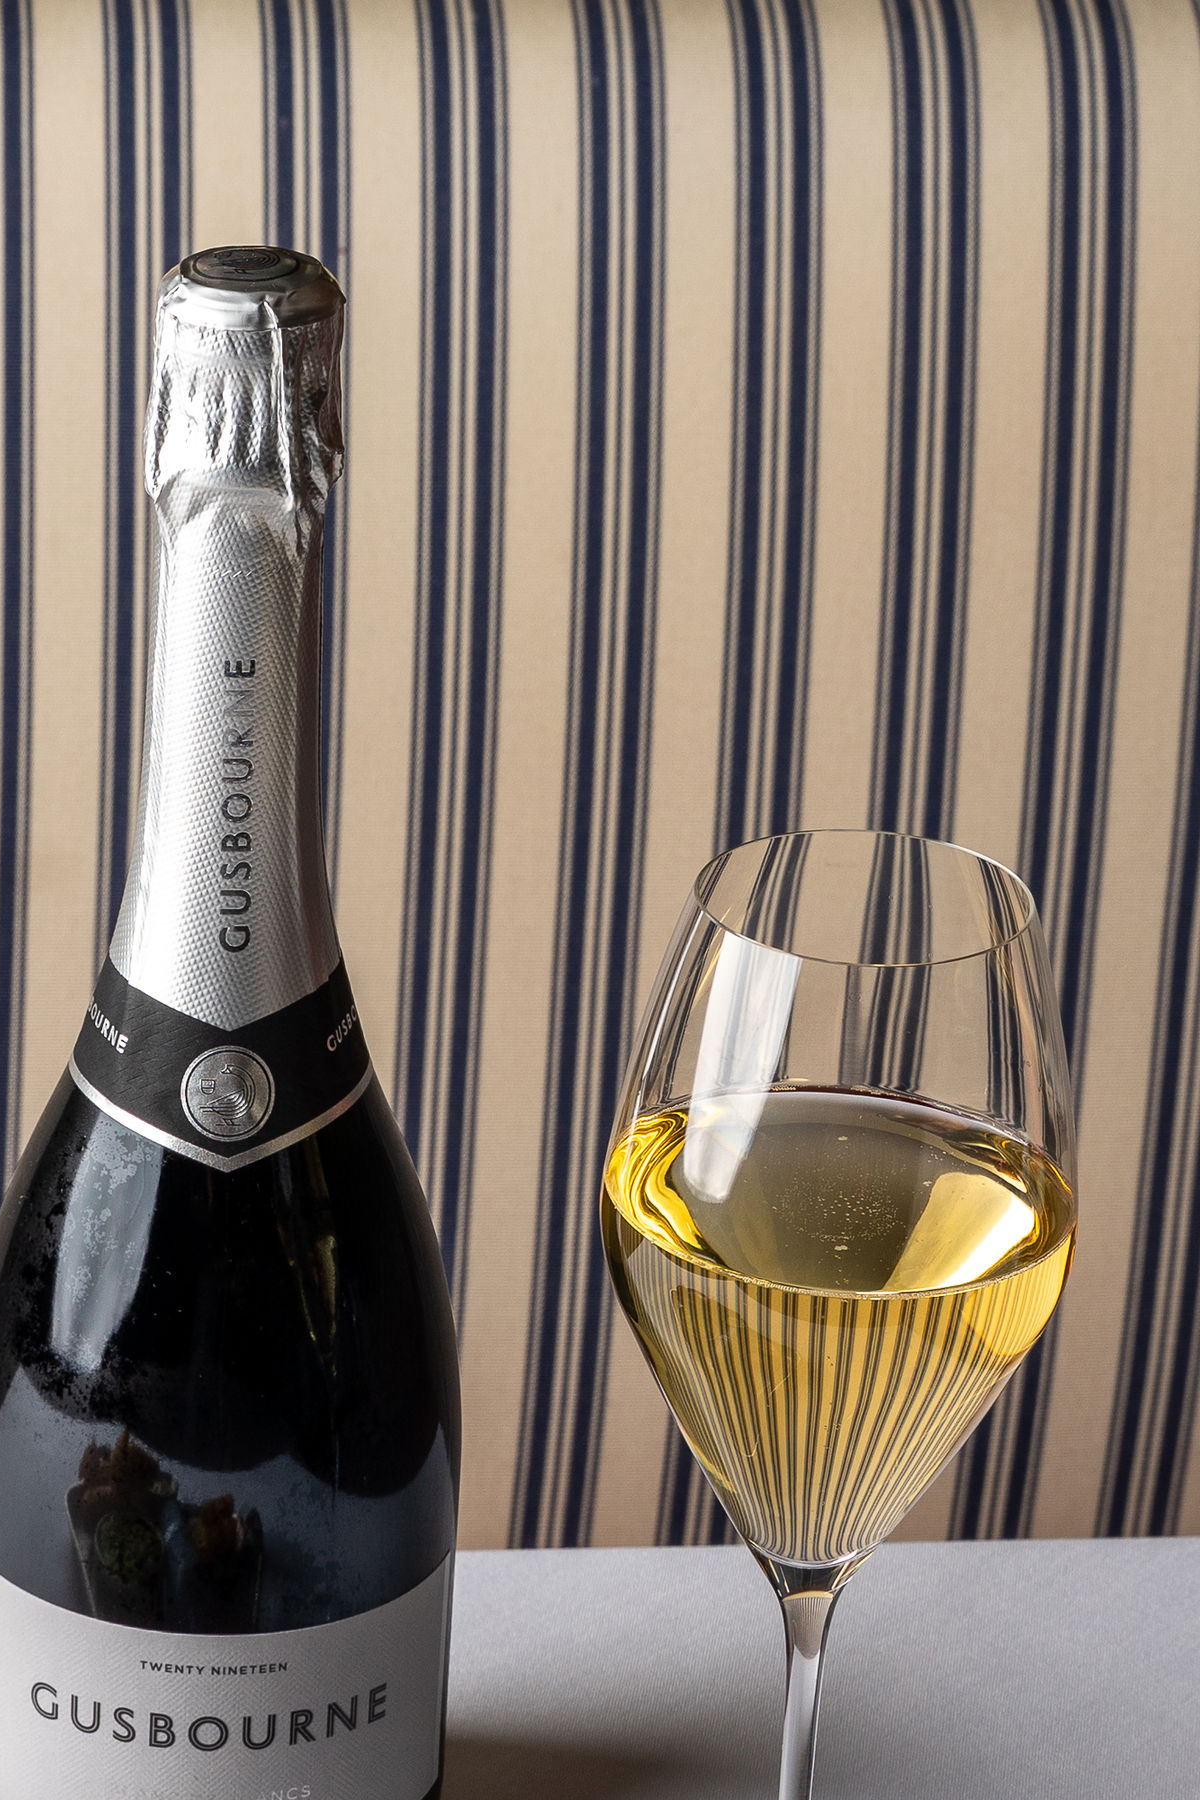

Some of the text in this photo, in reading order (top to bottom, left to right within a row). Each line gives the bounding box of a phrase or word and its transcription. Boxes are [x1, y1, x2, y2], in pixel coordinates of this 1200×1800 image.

[219, 659, 256, 953] GUSBOURNE
[88, 1002, 129, 1054] OURNE
[140, 1660, 288, 1676] TWENTY NINETEEN
[30, 1681, 388, 1752] GUSBOURNE
